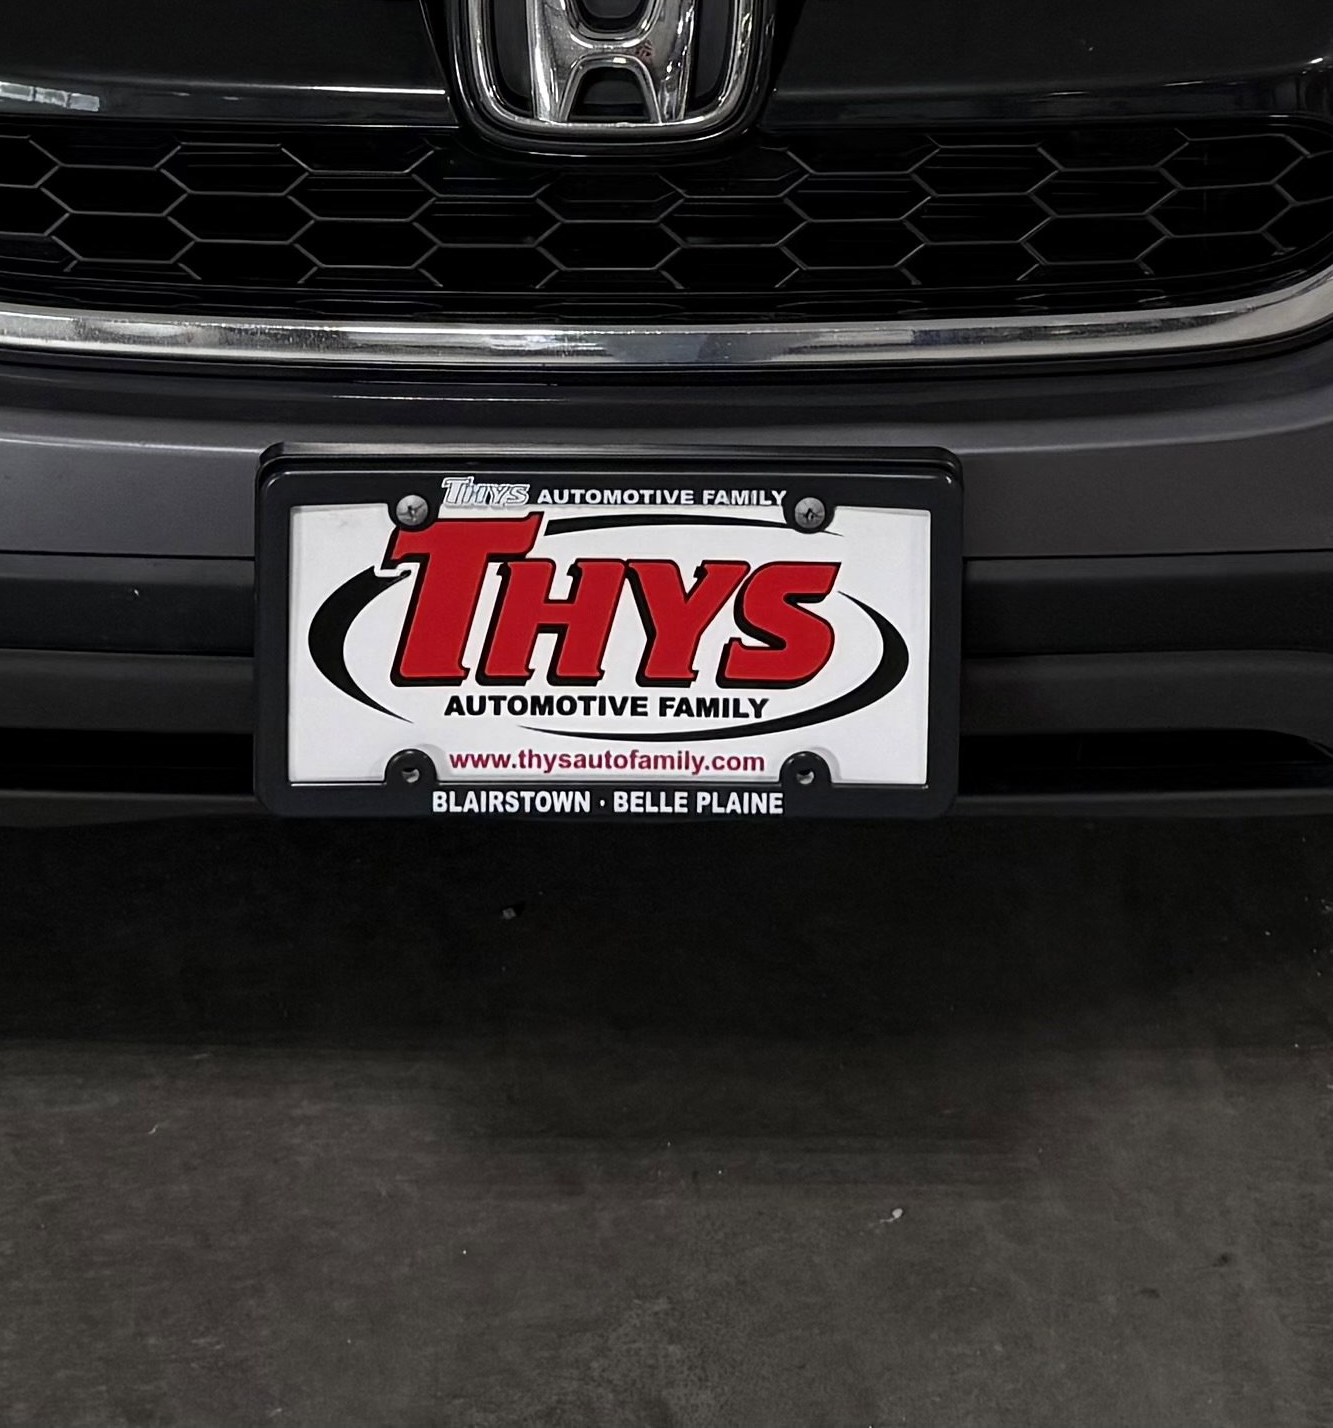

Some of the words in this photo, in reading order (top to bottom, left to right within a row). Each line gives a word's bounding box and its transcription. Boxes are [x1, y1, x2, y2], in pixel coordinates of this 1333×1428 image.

[537, 488, 694, 505] AUTOMOTIVE
[702, 489, 787, 506] FAMILY
[383, 511, 841, 689] THYS
[444, 695, 648, 717] AUTOMOTIVE
[658, 697, 770, 719] FAMILY
[449, 749, 765, 775] www.thysautofamily.com
[432, 791, 591, 814] BLAIRSTOWN
[613, 791, 692, 814] BELLE
[696, 792, 784, 815] PLAINE
